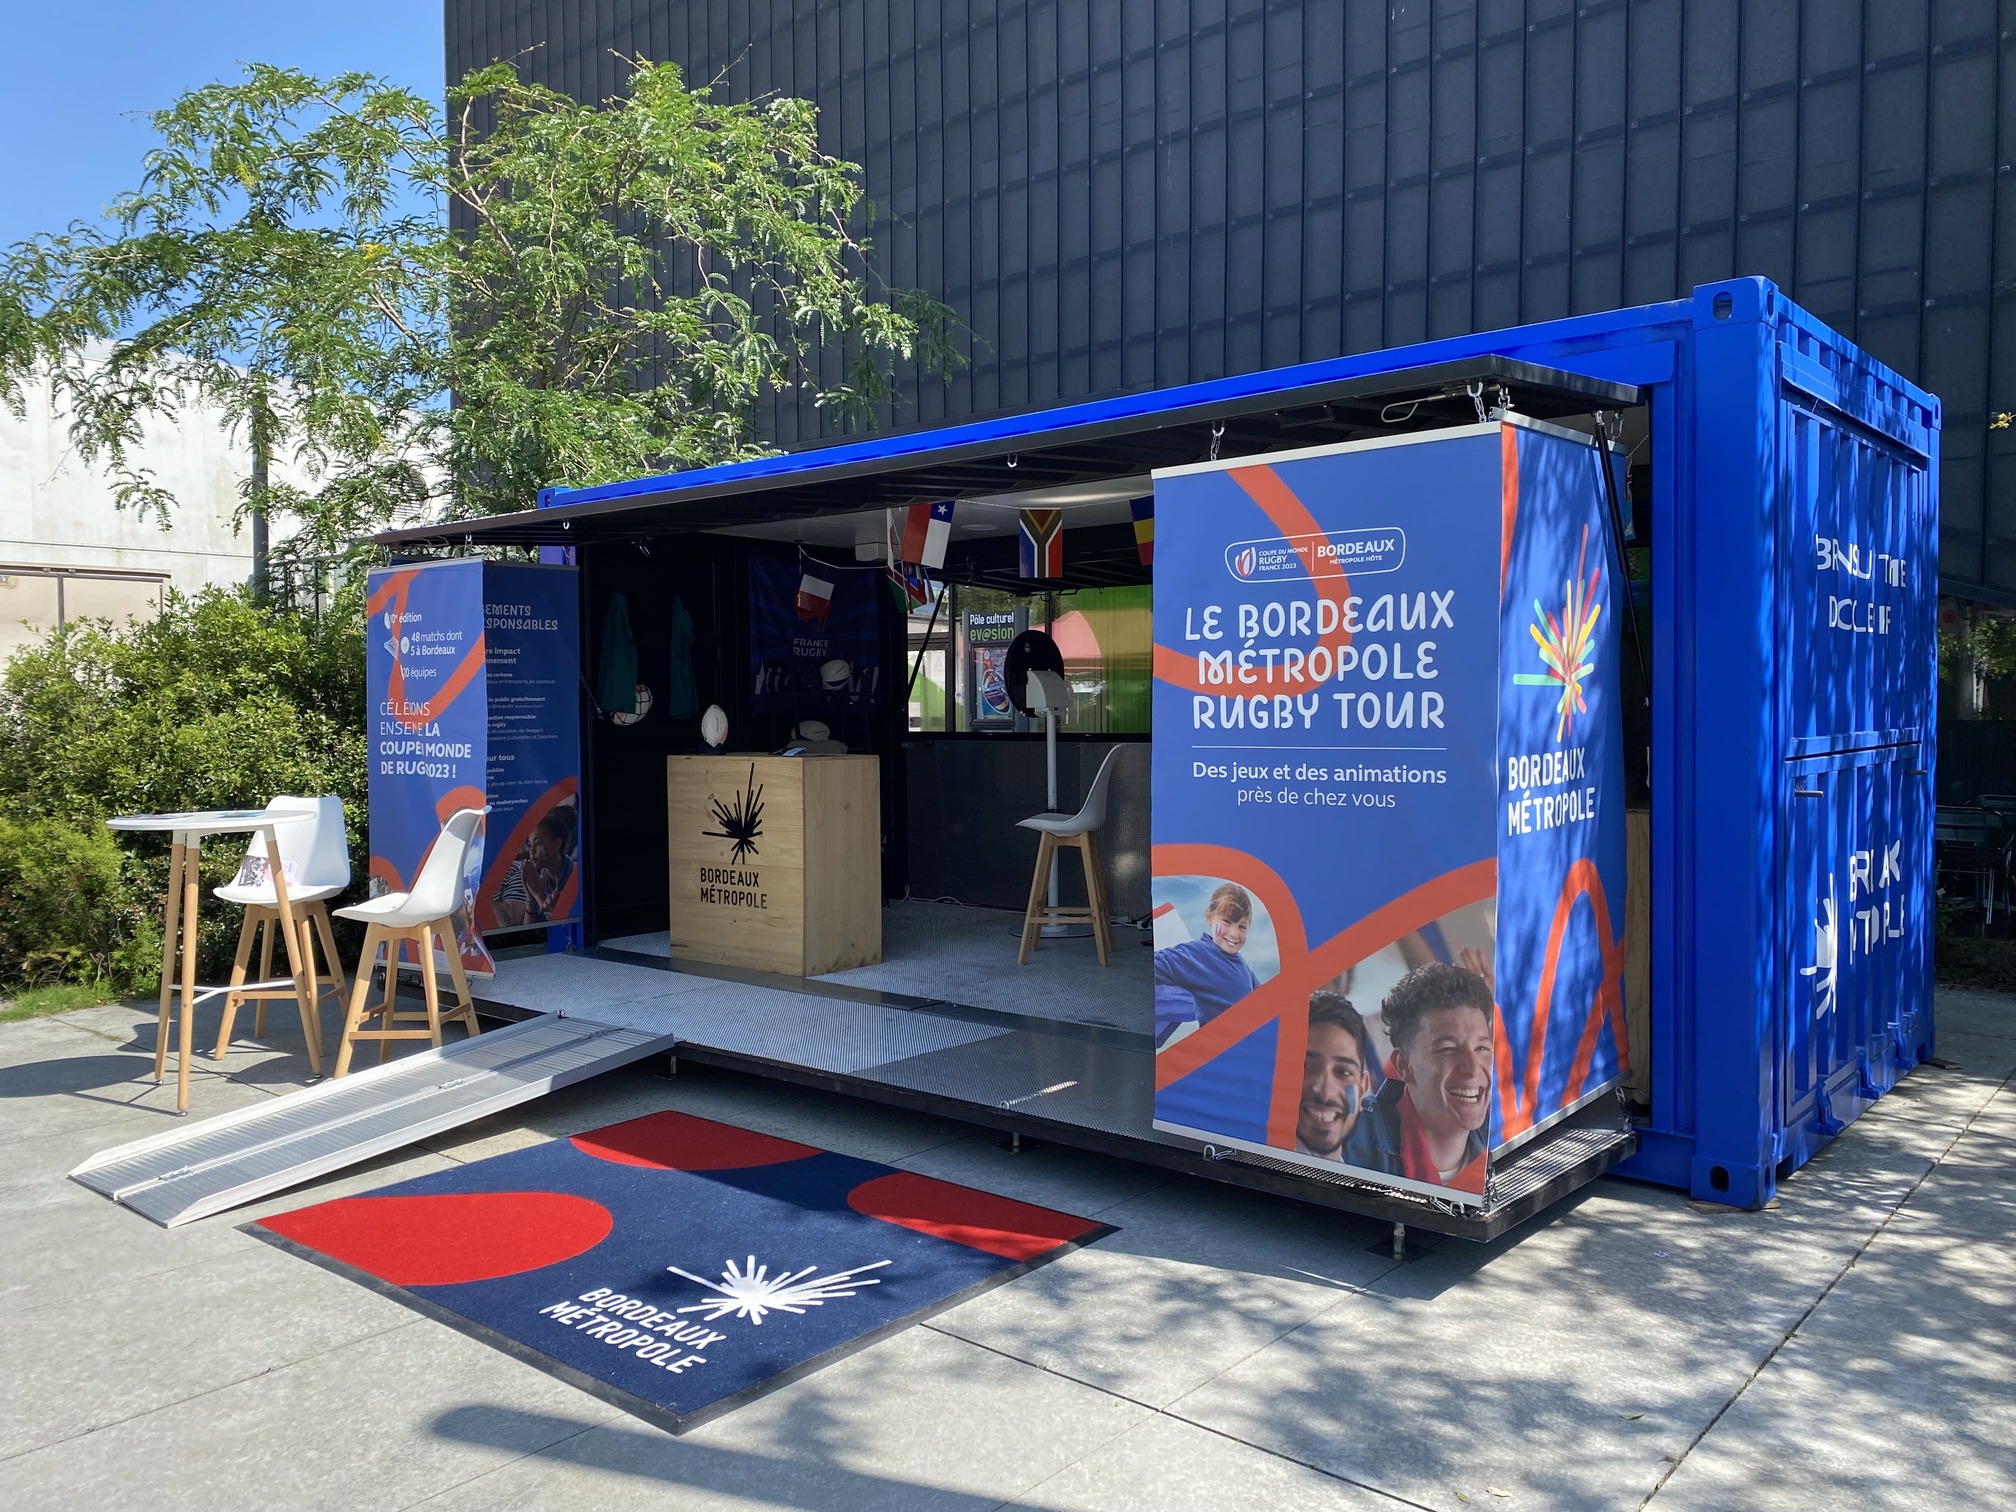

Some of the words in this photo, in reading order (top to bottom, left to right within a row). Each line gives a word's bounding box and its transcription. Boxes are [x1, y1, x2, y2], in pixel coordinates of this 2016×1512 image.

[1317, 539, 1395, 557] BORDEAUX
[1259, 555, 1287, 565] RUGBY
[1330, 556, 1365, 565] MÉTROPOLE
[1365, 554, 1383, 562] HÔTE
[399, 612, 422, 623] édition
[483, 604, 531, 616] EMENTS
[1185, 605, 1224, 641] LE
[1238, 590, 1455, 639] BORDEAUX
[484, 618, 558, 631] SPONSABLES
[970, 614, 985, 625] Pôle
[986, 611, 1015, 624] culturel
[411, 632, 420, 643] 48
[421, 630, 445, 642] matchs
[446, 630, 463, 641] dont
[970, 624, 1014, 641] ev@sion
[410, 645, 415, 656] 5
[416, 645, 421, 656] à
[422, 644, 456, 656] Bordeaux
[793, 638, 830, 648] FRANCE
[793, 647, 828, 657] RUGBY
[1198, 638, 1439, 685] MÉTROPOLE
[411, 667, 437, 680] équipes
[1193, 692, 1320, 729] RUGBY
[1333, 691, 1445, 729] TOUR
[425, 723, 441, 737] LA
[425, 743, 472, 758] MONDE
[381, 761, 395, 775] DE
[1193, 761, 1228, 778] Des
[1231, 761, 1269, 783] jeux
[1272, 764, 1291, 780] et
[1295, 763, 1329, 781] des
[1333, 764, 1447, 784] animations
[1508, 747, 1585, 791] BORDEAUX
[1237, 786, 1272, 805] près
[1277, 787, 1299, 804] de
[1303, 788, 1347, 806] chez
[1352, 792, 1396, 808] vous
[1508, 789, 1595, 836] MÉTROPOLE
[700, 867, 759, 888] BORDEAUX
[700, 884, 768, 909] MÉTROPOLE
[578, 1287, 727, 1350] BORDEAUX
[538, 1300, 707, 1374] MÉTROPOLE
